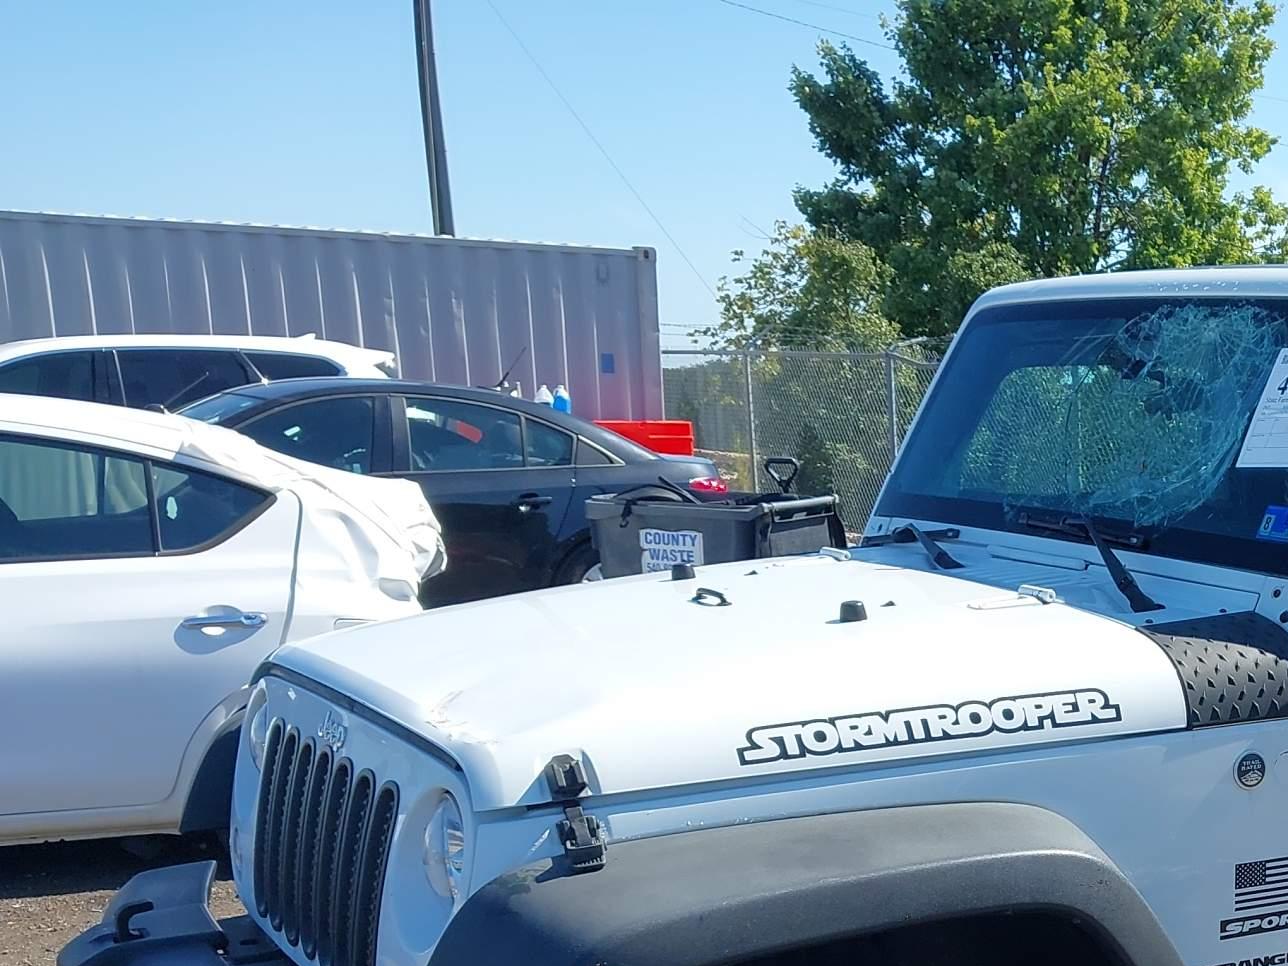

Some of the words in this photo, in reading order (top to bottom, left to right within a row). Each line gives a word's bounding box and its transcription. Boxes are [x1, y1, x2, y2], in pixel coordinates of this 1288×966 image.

[1263, 516, 1273, 531] 8
[644, 531, 698, 547] COUNTY
[648, 547, 695, 563] WASTE
[317, 710, 345, 752] Jeep
[736, 687, 1123, 766] STORMTROOPER
